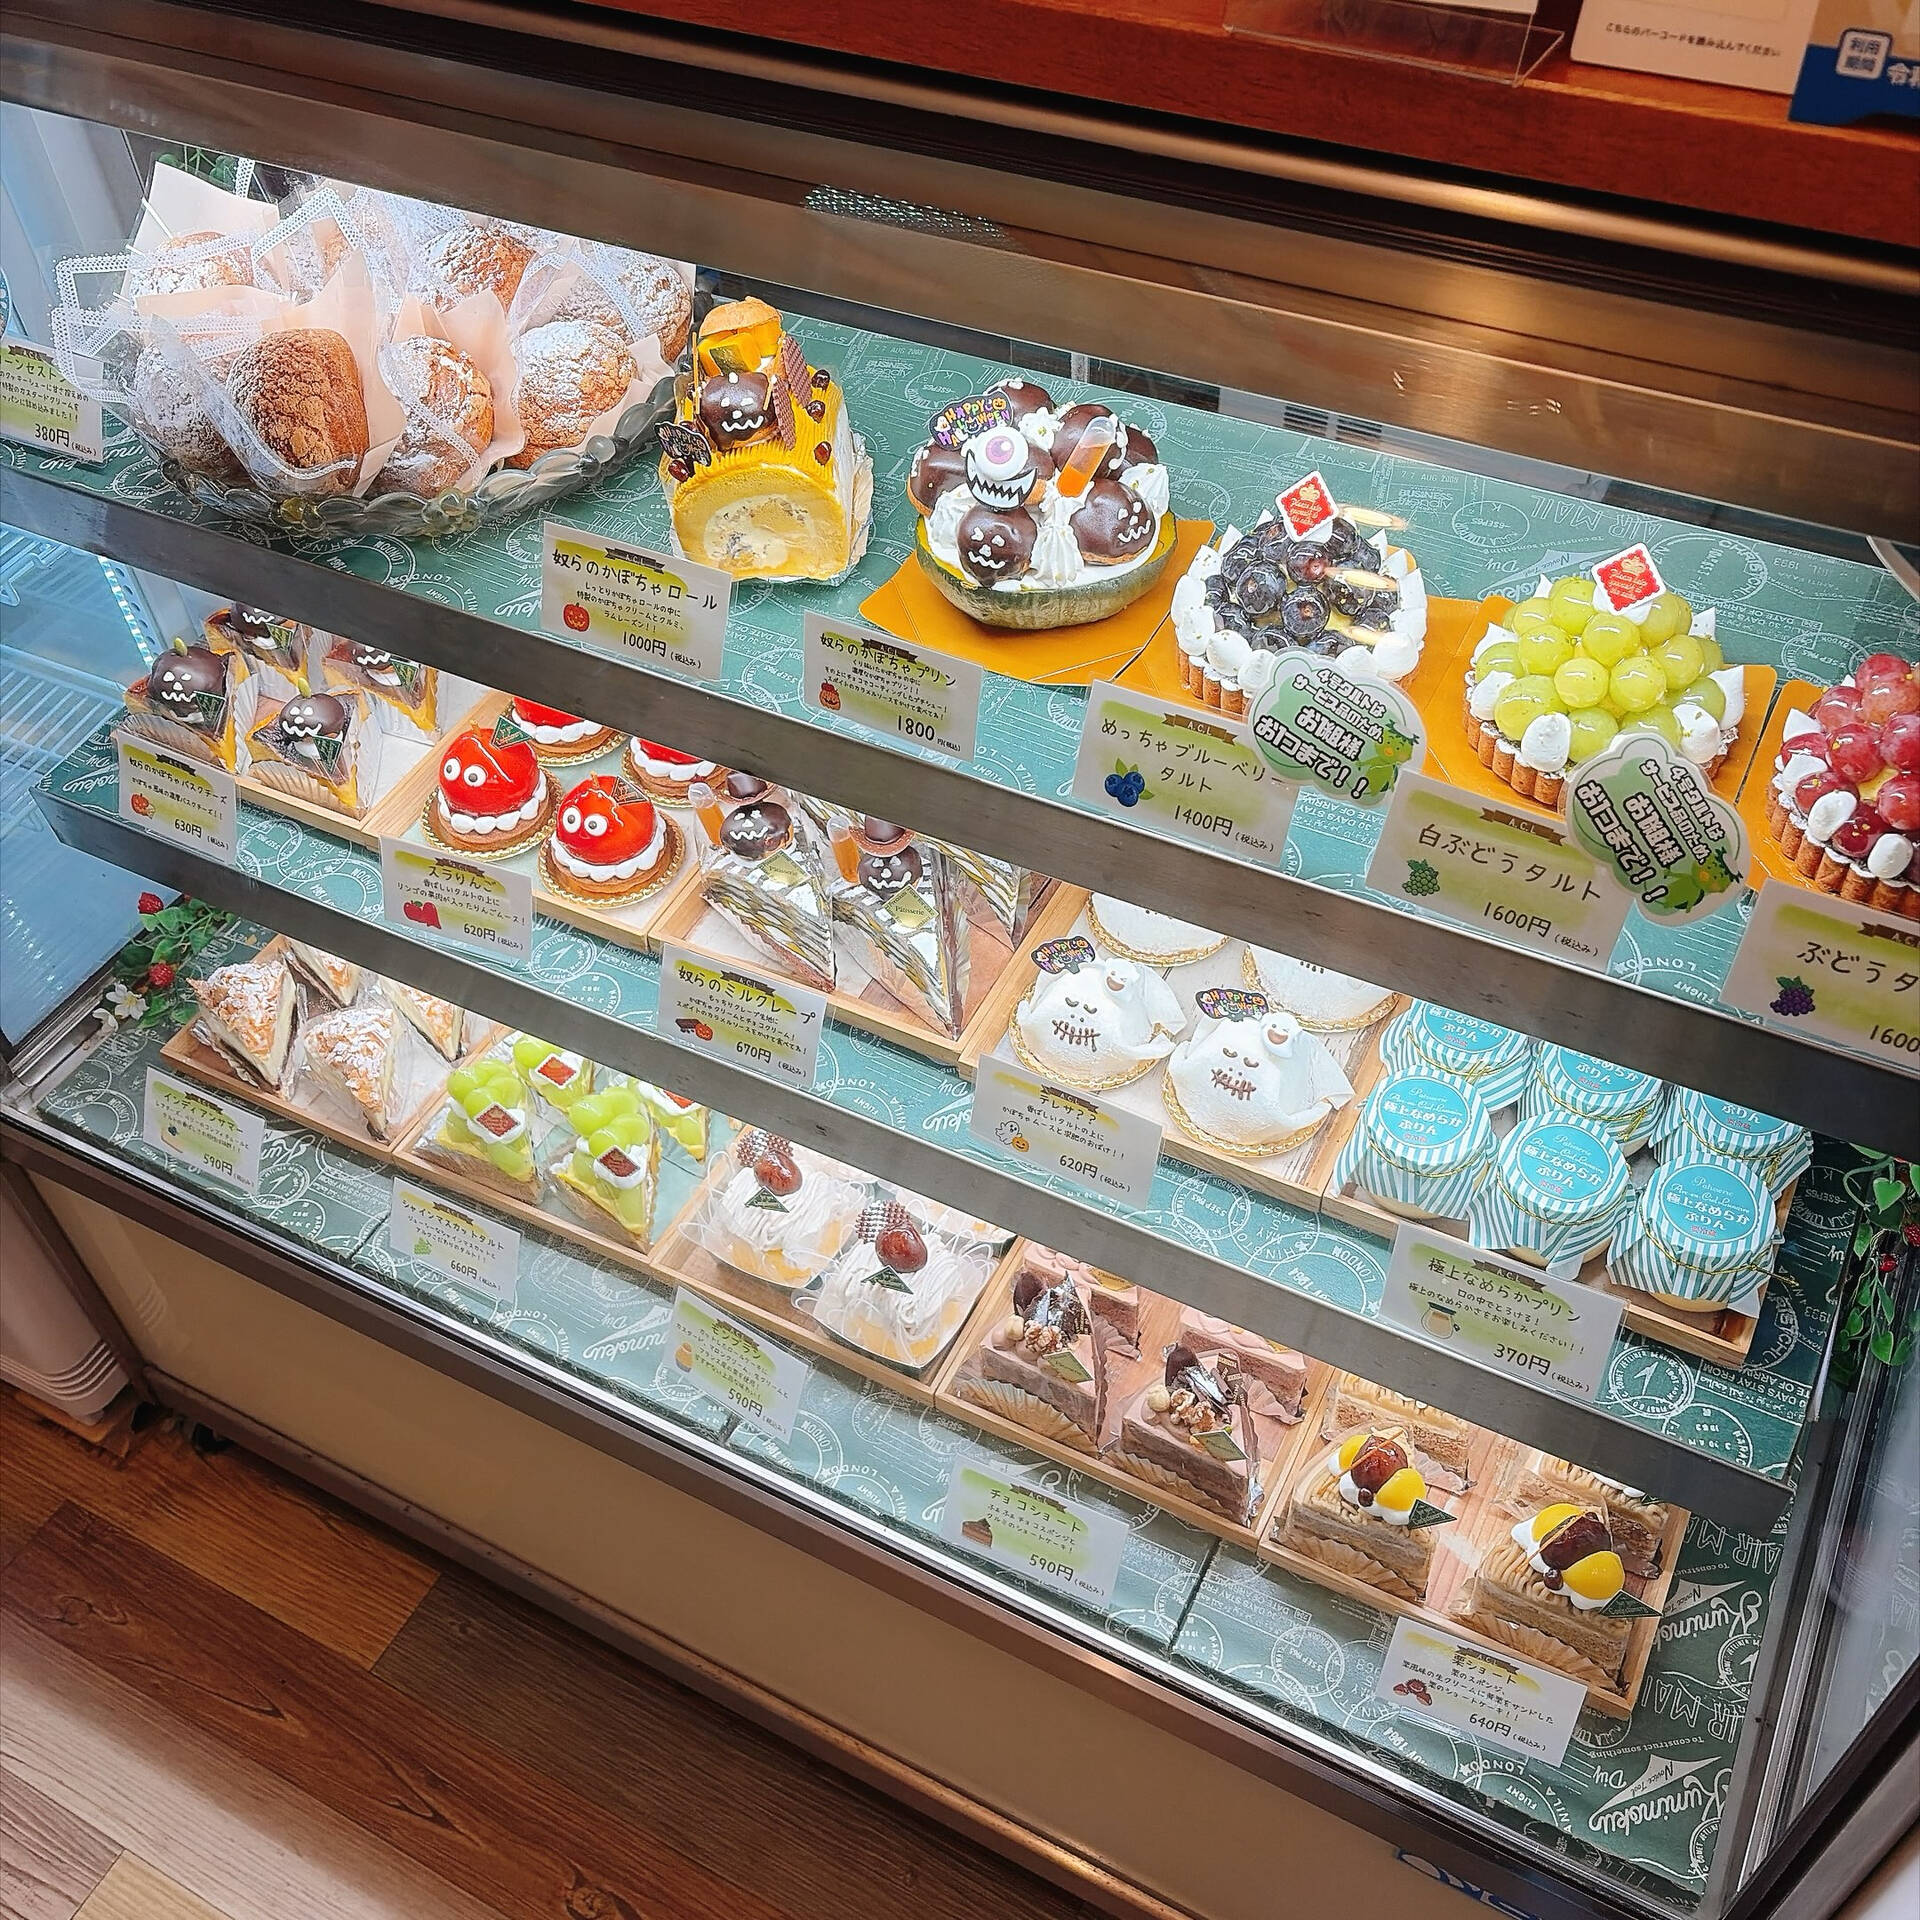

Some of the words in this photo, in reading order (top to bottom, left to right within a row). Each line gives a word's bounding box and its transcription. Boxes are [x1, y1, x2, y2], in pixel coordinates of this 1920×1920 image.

[1606, 22, 1780, 57] こちらのバーコードを読み込んでください
[1849, 36, 1880, 55] 利用
[944, 398, 985, 425] HAPPY
[35, 423, 70, 448] 380円
[552, 549, 717, 610] 奴らのかぼちゃロール
[585, 582, 681, 618] しっとりかぼちゃロールの中に
[623, 631, 667, 657] 1000円
[820, 632, 957, 687] 奴らのかぼちゃプリン
[1316, 667, 1387, 718] 4号タルトは
[897, 715, 935, 741] 1800
[1187, 721, 1213, 737] A.C.L
[1101, 718, 1284, 783] めっちゃブルーベリー
[129, 757, 227, 805] 奴らのかぼちゃバスクチーズ
[1160, 766, 1213, 793] タルト
[1670, 765, 1726, 842] 4号タルトは
[174, 818, 203, 839] 630円
[1174, 804, 1234, 837] 1400円
[1508, 818, 1537, 834] A.C.L
[1418, 823, 1601, 902] 白ぶどうタルト
[428, 866, 496, 892] スラりんご
[464, 924, 496, 942] 620円
[1483, 902, 1551, 938] 1600円
[1796, 941, 1920, 993] ぶどうタ
[678, 966, 815, 1024] 奴らのミルクレープ
[1442, 1024, 1478, 1043] ぷりん
[736, 1041, 771, 1064] 670円
[1575, 1061, 1613, 1085] ぷりん
[164, 1093, 243, 1134] インディアンサマー
[1384, 1101, 1463, 1129] 極上なめらか
[1399, 1119, 1437, 1136] ぷりん
[1721, 1103, 1763, 1125] ぷりん
[203, 1153, 233, 1176] 590円
[1059, 1155, 1098, 1179] 620円
[1523, 1144, 1603, 1187] 極上なめらか
[1536, 1165, 1576, 1190] ぷりん
[1666, 1191, 1751, 1226] 極上なめらか
[1685, 1211, 1728, 1232] ぷりん
[402, 1199, 504, 1251] シャインマスカットタルト
[450, 1260, 478, 1279] 660円
[1428, 1257, 1581, 1322] 極上なめらかプリン
[1408, 1282, 1585, 1354] 極上のなめらかさをお楽しみください！！
[1457, 1289, 1540, 1326] 口の中でとろける！
[711, 1323, 761, 1360] モンブラン
[1494, 1343, 1551, 1377] 370円
[1701, 1362, 1736, 1382] FROM
[1736, 1375, 1763, 1392] STAY
[728, 1388, 763, 1418] 590円
[990, 1488, 1081, 1533] チョコショート
[1029, 1553, 1074, 1582] 590円
[1451, 1652, 1518, 1686] 栗ショート
[1469, 1713, 1512, 1738] 640円
